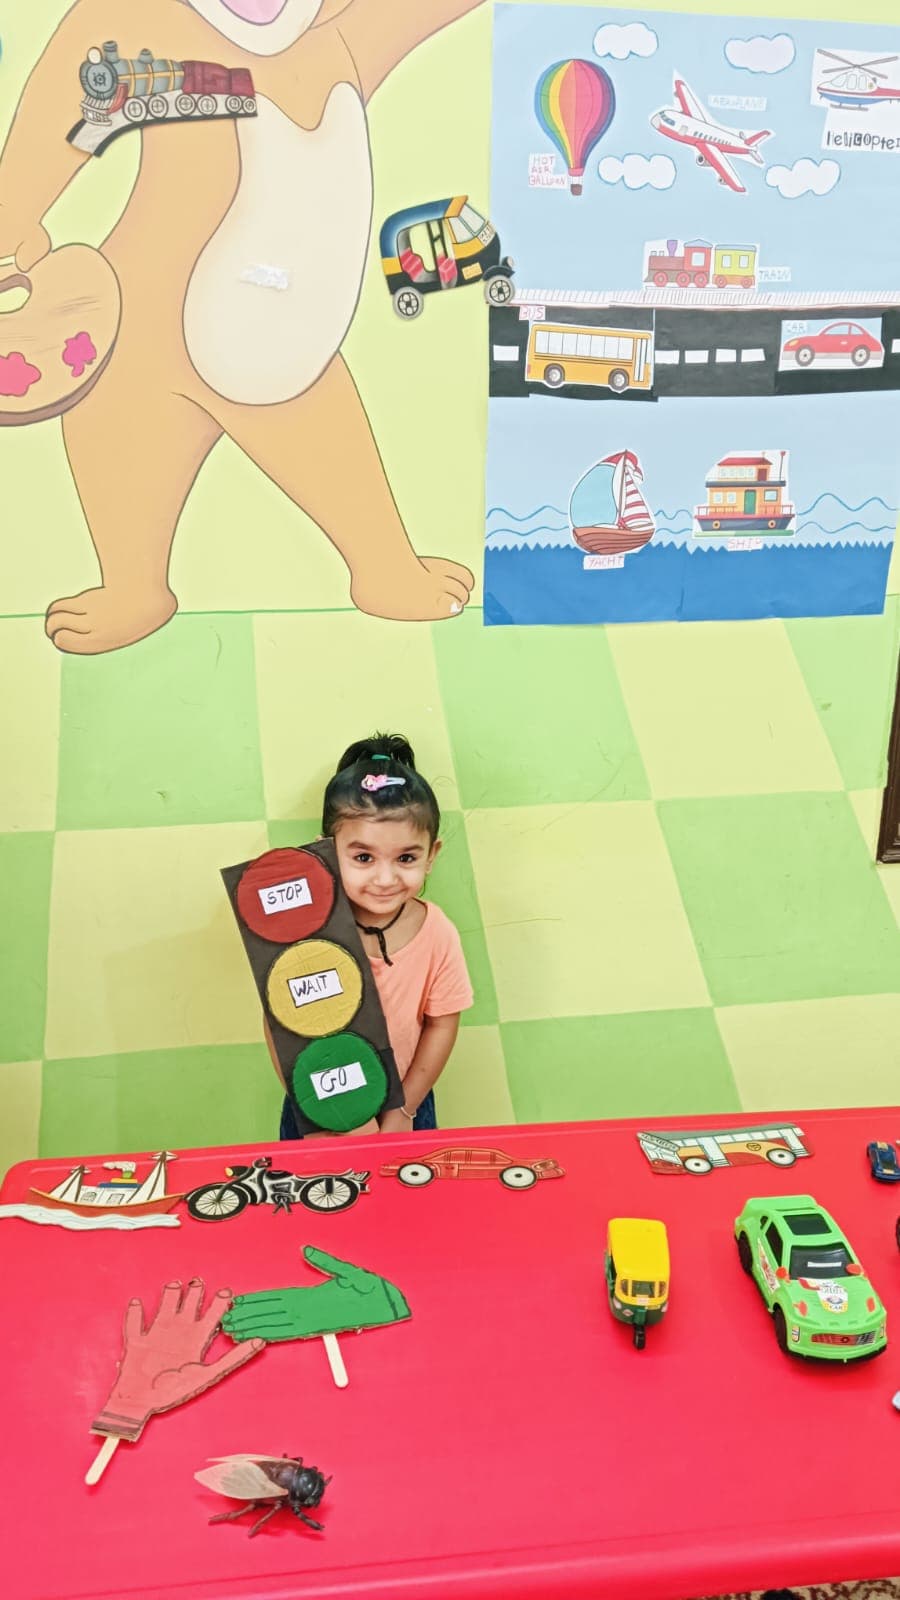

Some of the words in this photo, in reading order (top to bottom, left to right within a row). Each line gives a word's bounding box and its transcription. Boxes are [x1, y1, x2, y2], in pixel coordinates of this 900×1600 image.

[533, 156, 554, 165] HOT
[759, 269, 789, 280] TRAIN
[520, 305, 544, 319] BUS
[785, 322, 806, 333] CAR
[728, 537, 761, 549] SHIP
[587, 556, 624, 568] YACHT
[267, 883, 303, 905] STOP
[293, 974, 328, 997] WAIT
[320, 1067, 347, 1093] GO
